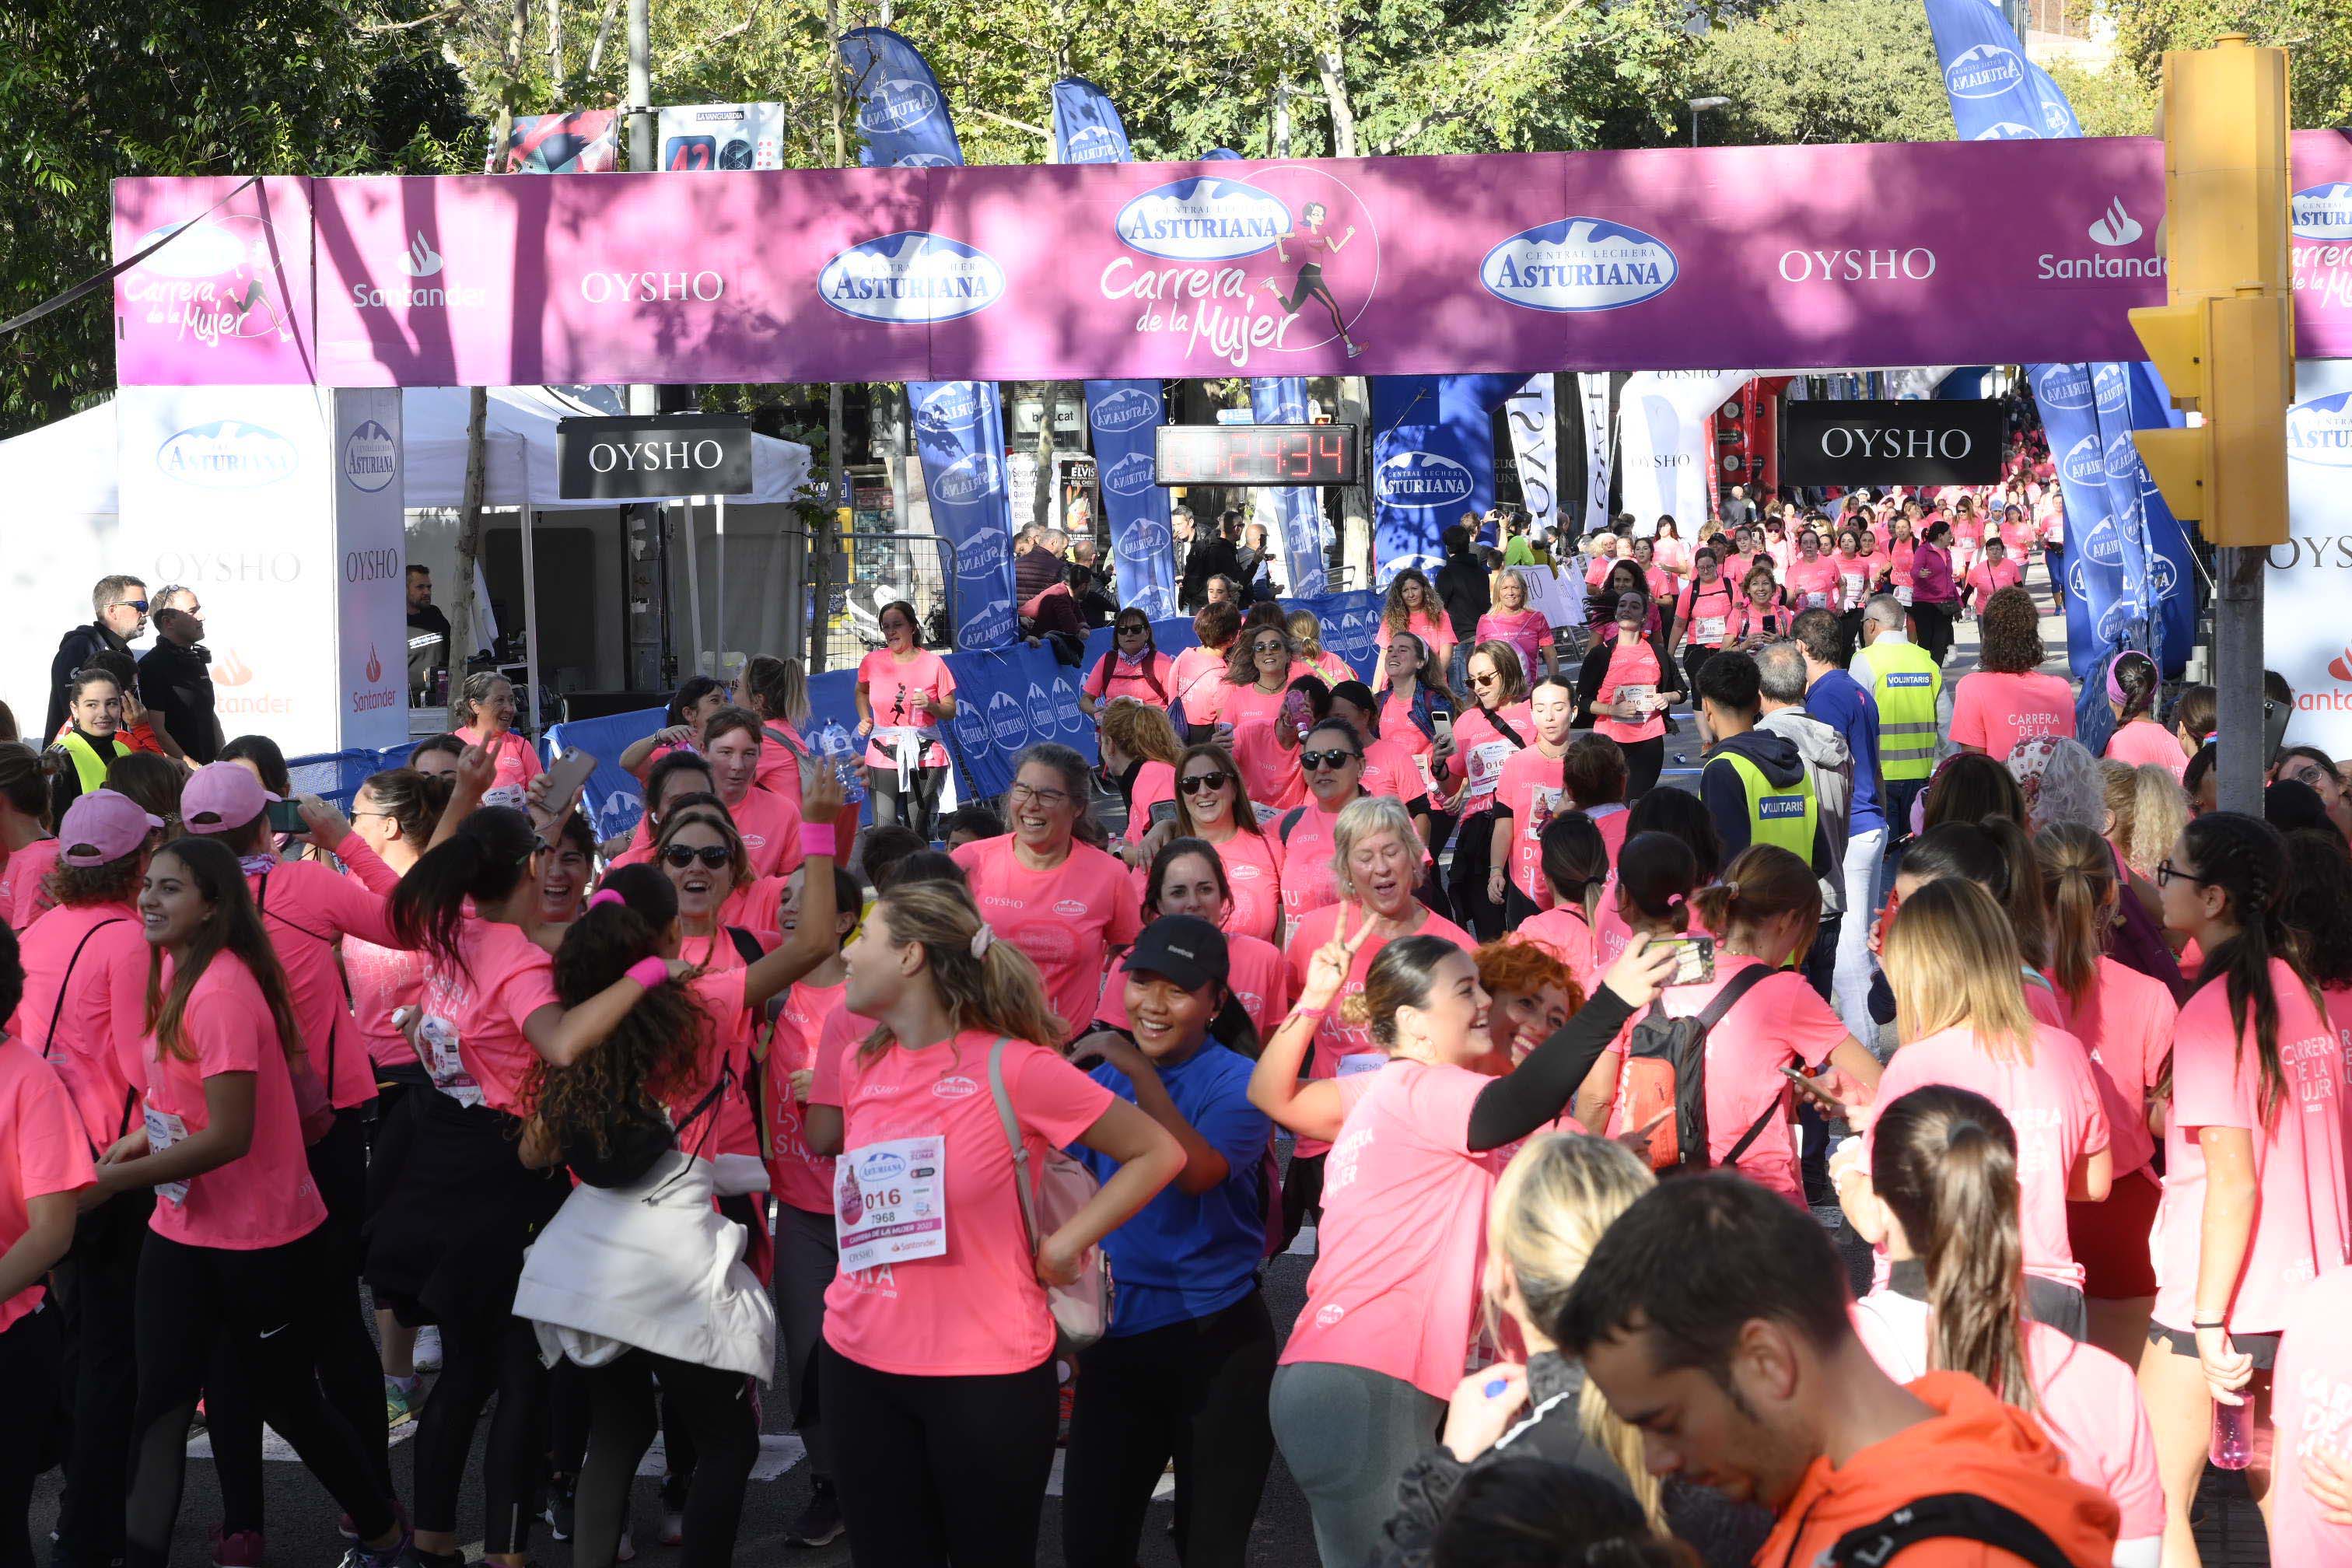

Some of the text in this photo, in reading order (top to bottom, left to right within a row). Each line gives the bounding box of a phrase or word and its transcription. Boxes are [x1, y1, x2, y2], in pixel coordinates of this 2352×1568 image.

[706, 111, 744, 121] VANGUARDIA
[1129, 209, 1279, 240] ASTURIANA
[1525, 248, 1657, 261] CENTRAL LECHERA
[1779, 247, 1937, 282] OYSHO
[832, 267, 989, 299] ASTURIANA
[1101, 257, 1246, 300] Carrera
[1496, 254, 1663, 289] ASTURIANA
[2311, 269, 2324, 290] la
[123, 275, 219, 303] Carrera
[353, 283, 487, 307] Santander
[582, 271, 724, 303] OYSHO
[179, 300, 250, 348] Mujer
[1136, 297, 1300, 367] de la Mujer
[1822, 427, 1972, 459] OYSHO
[2287, 421, 2352, 449] ASTU
[348, 448, 393, 474] ASTURIANA
[589, 439, 723, 473] OYSHO
[1632, 453, 1690, 467] OYSHO
[1071, 467, 1096, 478] ELVIS
[1378, 475, 1466, 495] ASTURIANA
[156, 550, 301, 584] OYSHO
[346, 548, 398, 583] OYSHO
[1888, 675, 1930, 685] VOLUNTARIS
[216, 692, 292, 716] tander
[354, 689, 396, 713] Santander
[994, 716, 1027, 739] ASTURIANA
[2008, 713, 2060, 725] CARRERA
[2019, 726, 2050, 737] DE LA
[985, 897, 1024, 909] OYSHO
[1055, 905, 1087, 913] ASTURIANA
[866, 1188, 902, 1210] 016
[881, 1228, 891, 1237] LA
[892, 1224, 915, 1235] MUJER
[900, 1238, 937, 1252] Santander
